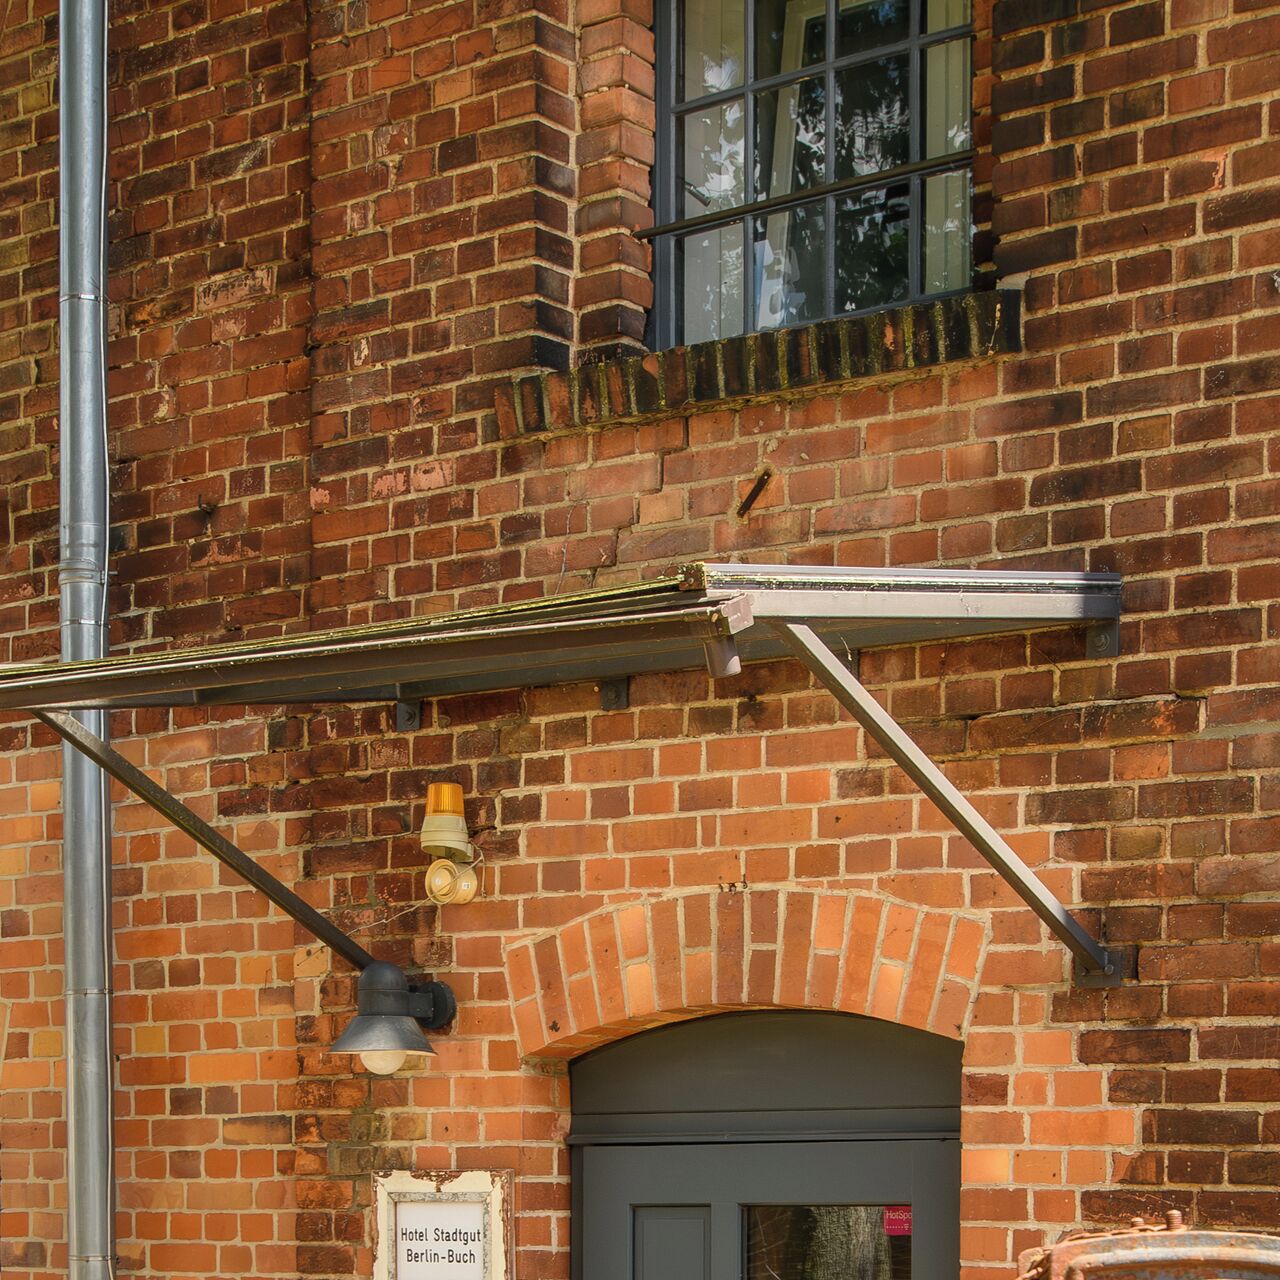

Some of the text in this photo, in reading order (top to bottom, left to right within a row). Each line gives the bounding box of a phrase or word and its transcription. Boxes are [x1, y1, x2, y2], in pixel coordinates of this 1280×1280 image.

[886, 1210, 912, 1221] HotSpo
[401, 1227, 481, 1245] Hotel Stadtgut
[406, 1248, 476, 1263] Berlin-Buch
